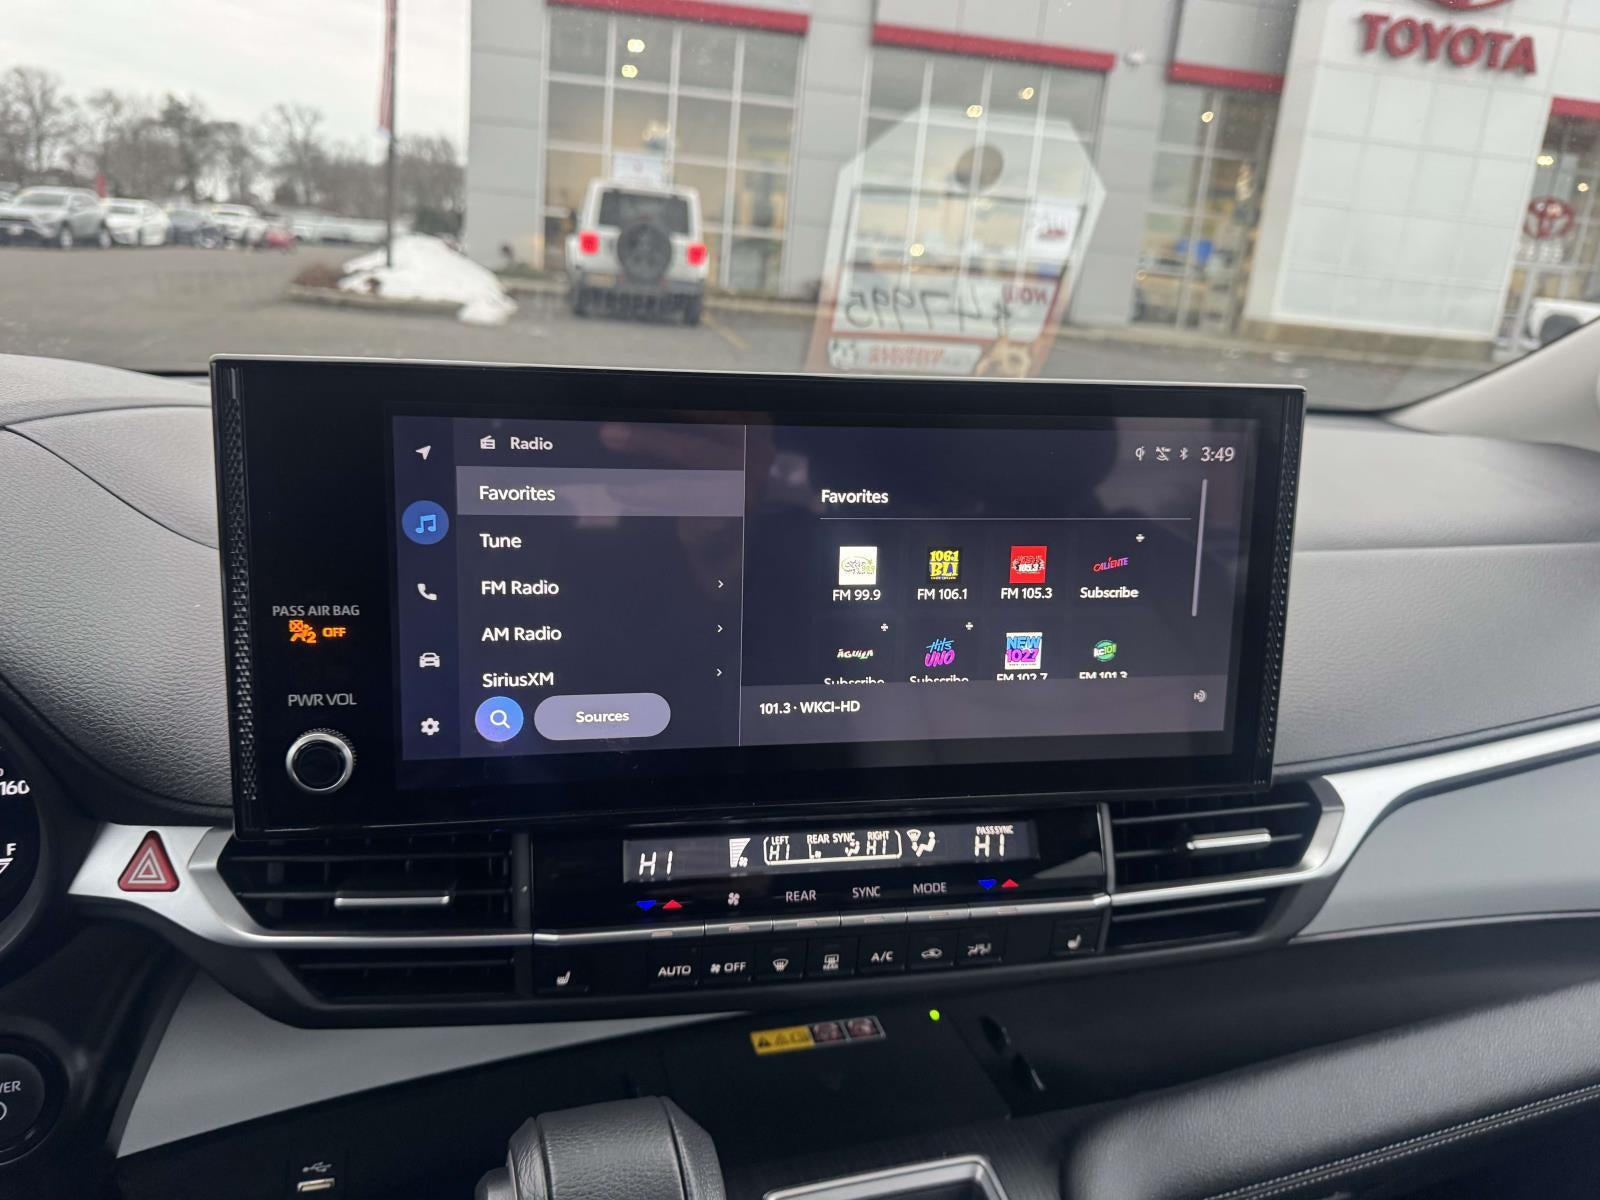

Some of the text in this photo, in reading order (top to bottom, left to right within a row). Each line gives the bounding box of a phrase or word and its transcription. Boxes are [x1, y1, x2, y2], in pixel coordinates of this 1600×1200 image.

[1362, 14, 1536, 74] TOYOTA
[510, 436, 553, 451] Radio
[1201, 446, 1235, 462] 3:49
[479, 485, 556, 501] Favorites
[821, 489, 889, 505] Favorites
[480, 533, 522, 549] Tune
[481, 580, 559, 596] FM Radio
[917, 588, 968, 600] FM 106.1
[1000, 586, 1053, 599] FM 105.3
[1080, 586, 1139, 599] Subscribe
[832, 589, 881, 601] FM 99.9
[272, 605, 360, 617] PASS AIR BAG
[322, 626, 347, 638] OFF
[481, 626, 562, 642] AM Radio
[1006, 635, 1041, 649] NEW
[924, 650, 955, 667] UNO
[482, 671, 554, 688] SiriusXM
[288, 693, 357, 706] PWR VOL
[760, 700, 861, 715] 101.3 WKCI-HD
[575, 710, 629, 724] Sources
[771, 836, 789, 846] LEFT
[807, 832, 856, 844] REAR SYNC
[867, 831, 890, 841] RIGHT
[6, 843, 17, 856] F
[852, 886, 881, 899] SYNC
[913, 882, 947, 895] MODE
[785, 889, 816, 902] REAR
[870, 951, 894, 963] A/C
[658, 965, 692, 977] AUTO
[724, 961, 746, 973] OFF
